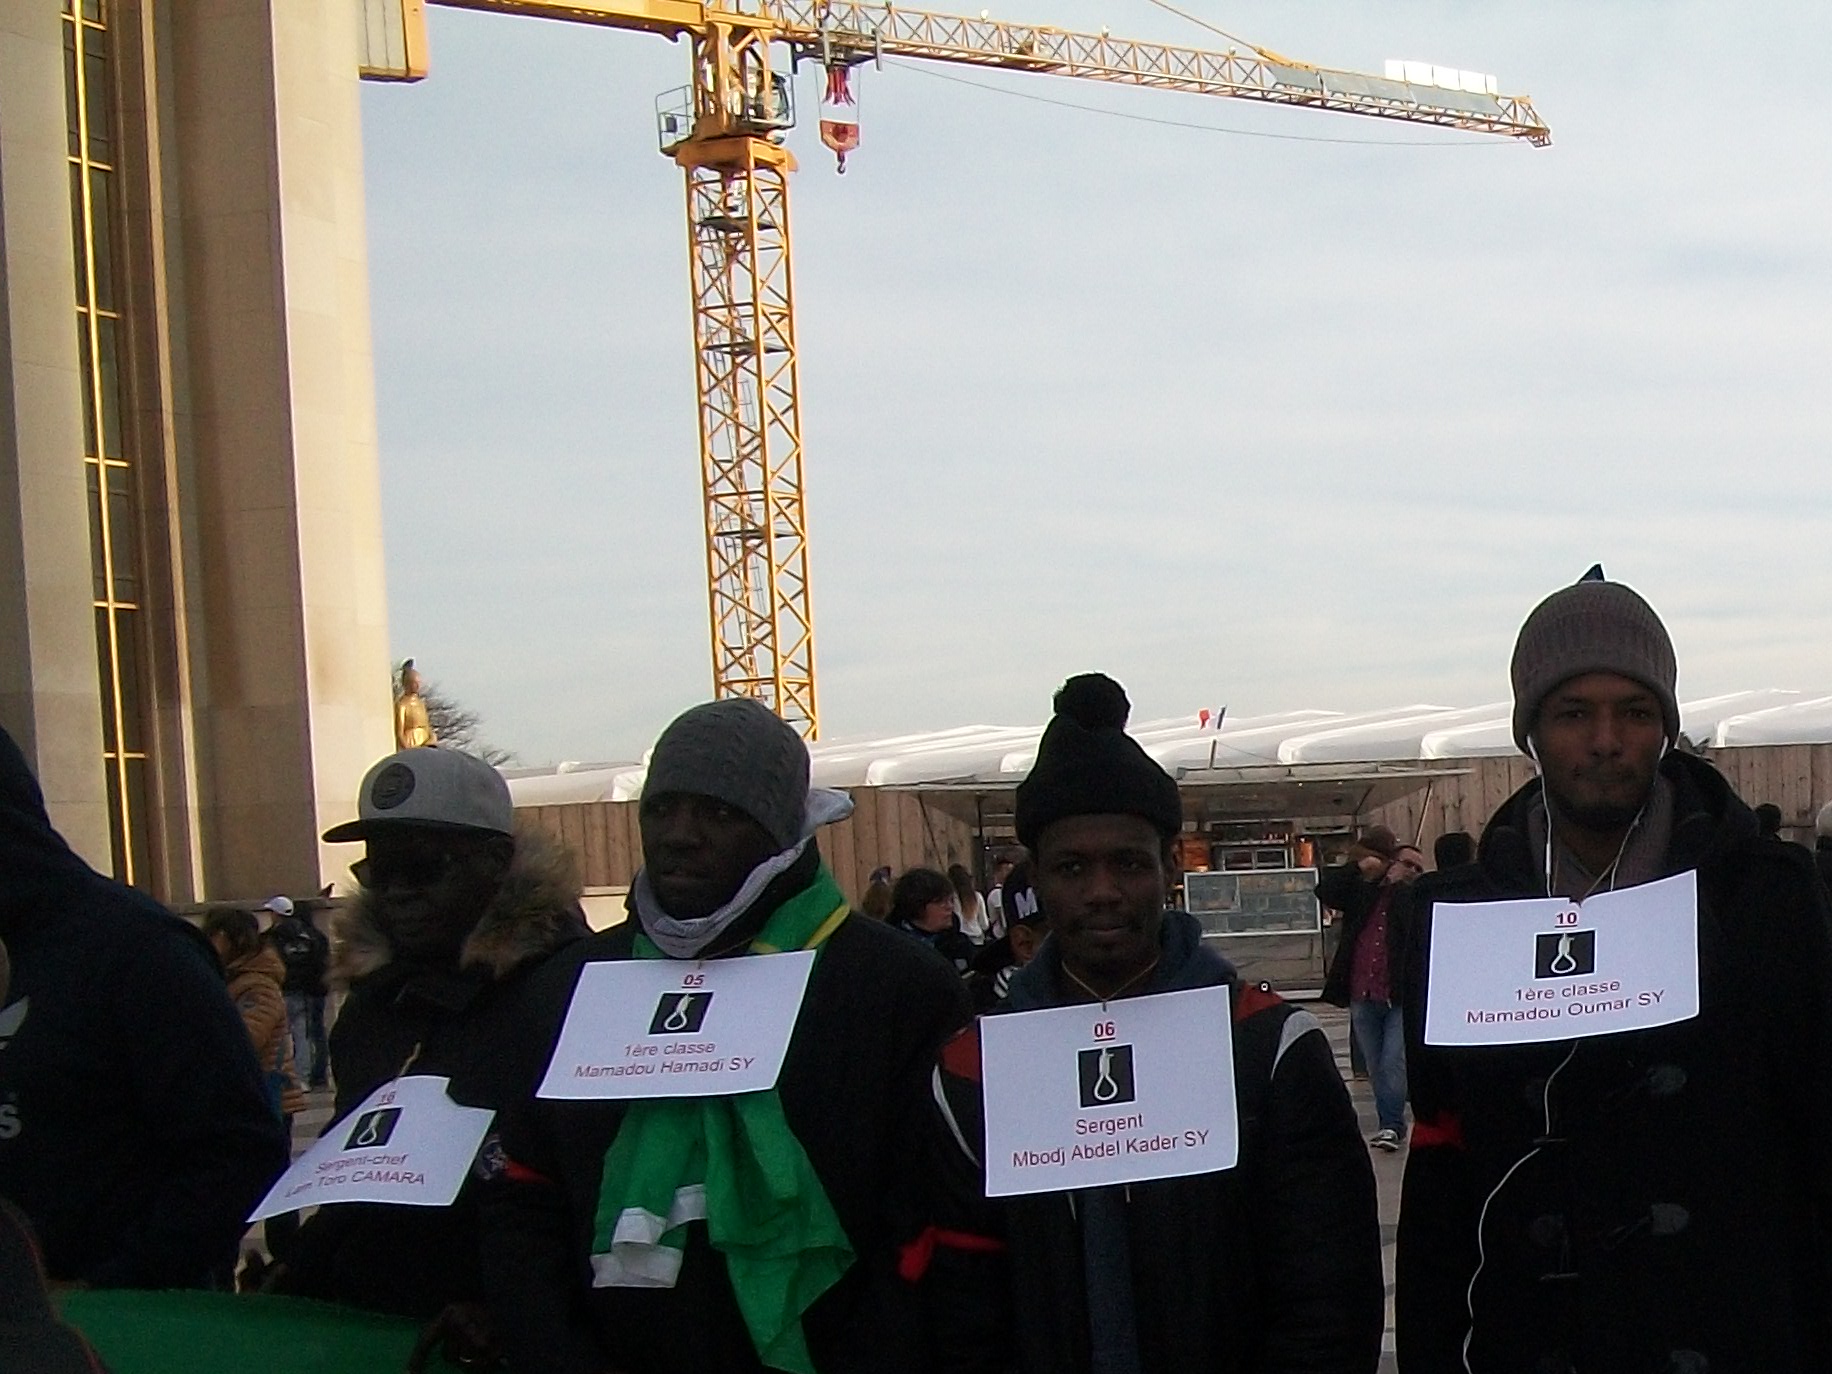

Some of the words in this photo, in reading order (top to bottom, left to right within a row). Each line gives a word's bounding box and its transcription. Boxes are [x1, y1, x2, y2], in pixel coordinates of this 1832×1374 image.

[1555, 911, 1578, 929] 10
[682, 973, 705, 989] 05
[1515, 988, 1556, 1001] 1ère
[1562, 979, 1621, 998] classe
[1466, 1006, 1561, 1024] Mamadou
[1567, 998, 1632, 1016] Oumar
[1637, 990, 1666, 1007] SY
[1093, 1021, 1116, 1041] 06
[664, 1042, 716, 1055] classe
[574, 1062, 656, 1078] Mamadou
[660, 1060, 725, 1074] Hamadi
[729, 1057, 756, 1071] SY
[1075, 1113, 1144, 1135] Sergent
[1012, 1148, 1066, 1167] Mbodj
[1071, 1142, 1121, 1161] Abdel
[1126, 1136, 1179, 1155] Kader
[1184, 1130, 1210, 1147] SY
[351, 1170, 425, 1185] CAMARA
